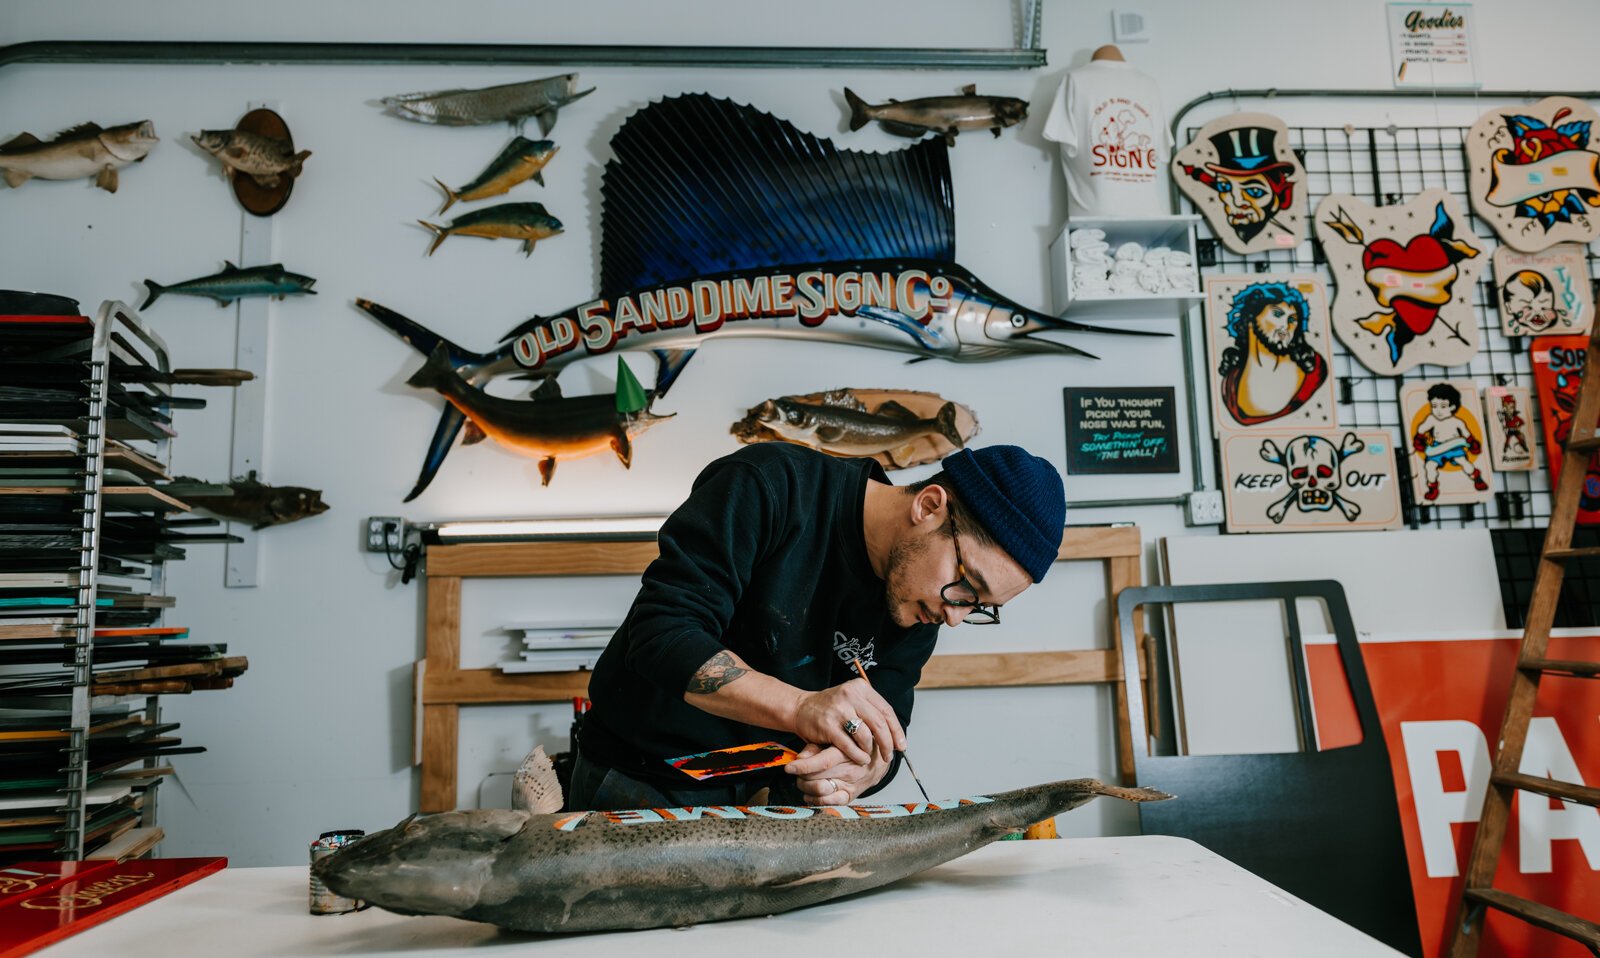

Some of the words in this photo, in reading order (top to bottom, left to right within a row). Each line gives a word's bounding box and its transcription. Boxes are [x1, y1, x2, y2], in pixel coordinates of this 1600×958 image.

[1405, 9, 1463, 32] Goodies
[1092, 144, 1143, 170] SIGN
[512, 317, 580, 369] OLD
[577, 298, 618, 354] 5
[613, 286, 694, 338] AND
[691, 274, 797, 333] DIME
[797, 270, 897, 327] SIGN
[1080, 397, 1092, 408] IF
[1094, 396, 1116, 408] YOU
[1117, 398, 1164, 407] THOUGHT
[1085, 410, 1120, 419] PICKIN'
[1123, 410, 1152, 418] YOUR
[1080, 420, 1108, 429] NOSE
[1110, 420, 1137, 428] WAS
[1081, 439, 1141, 452] SOMETHIN'
[1143, 438, 1165, 447] OFF
[1101, 450, 1120, 460] THE
[1122, 447, 1158, 458] WALL!
[1235, 473, 1283, 489] KEEP
[1346, 470, 1386, 487] OUT
